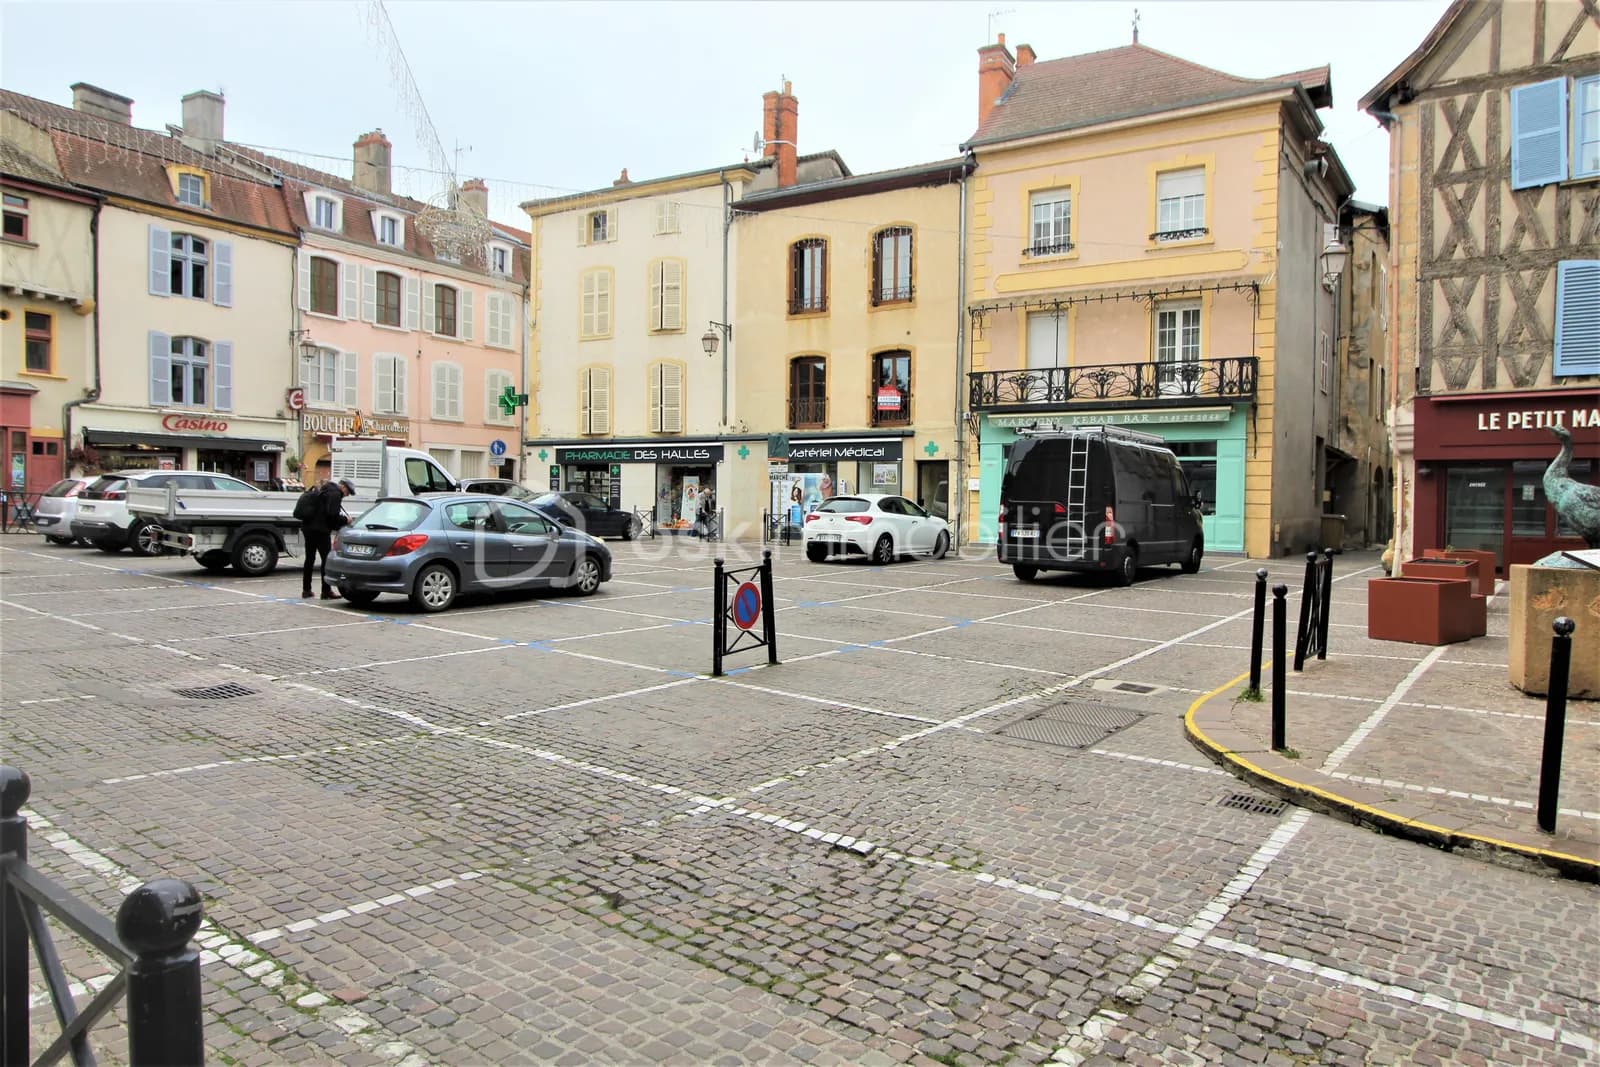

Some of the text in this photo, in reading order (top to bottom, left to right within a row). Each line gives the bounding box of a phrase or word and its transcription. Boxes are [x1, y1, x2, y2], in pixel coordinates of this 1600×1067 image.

[162, 414, 228, 432] Casino
[1072, 415, 1114, 424] KEBAB
[1124, 414, 1150, 423] BAR
[1478, 412, 1501, 430] LE
[1507, 410, 1566, 430] PETIT
[565, 448, 710, 460] PHARMACIE DES HALLES
[834, 446, 885, 457] Médical
